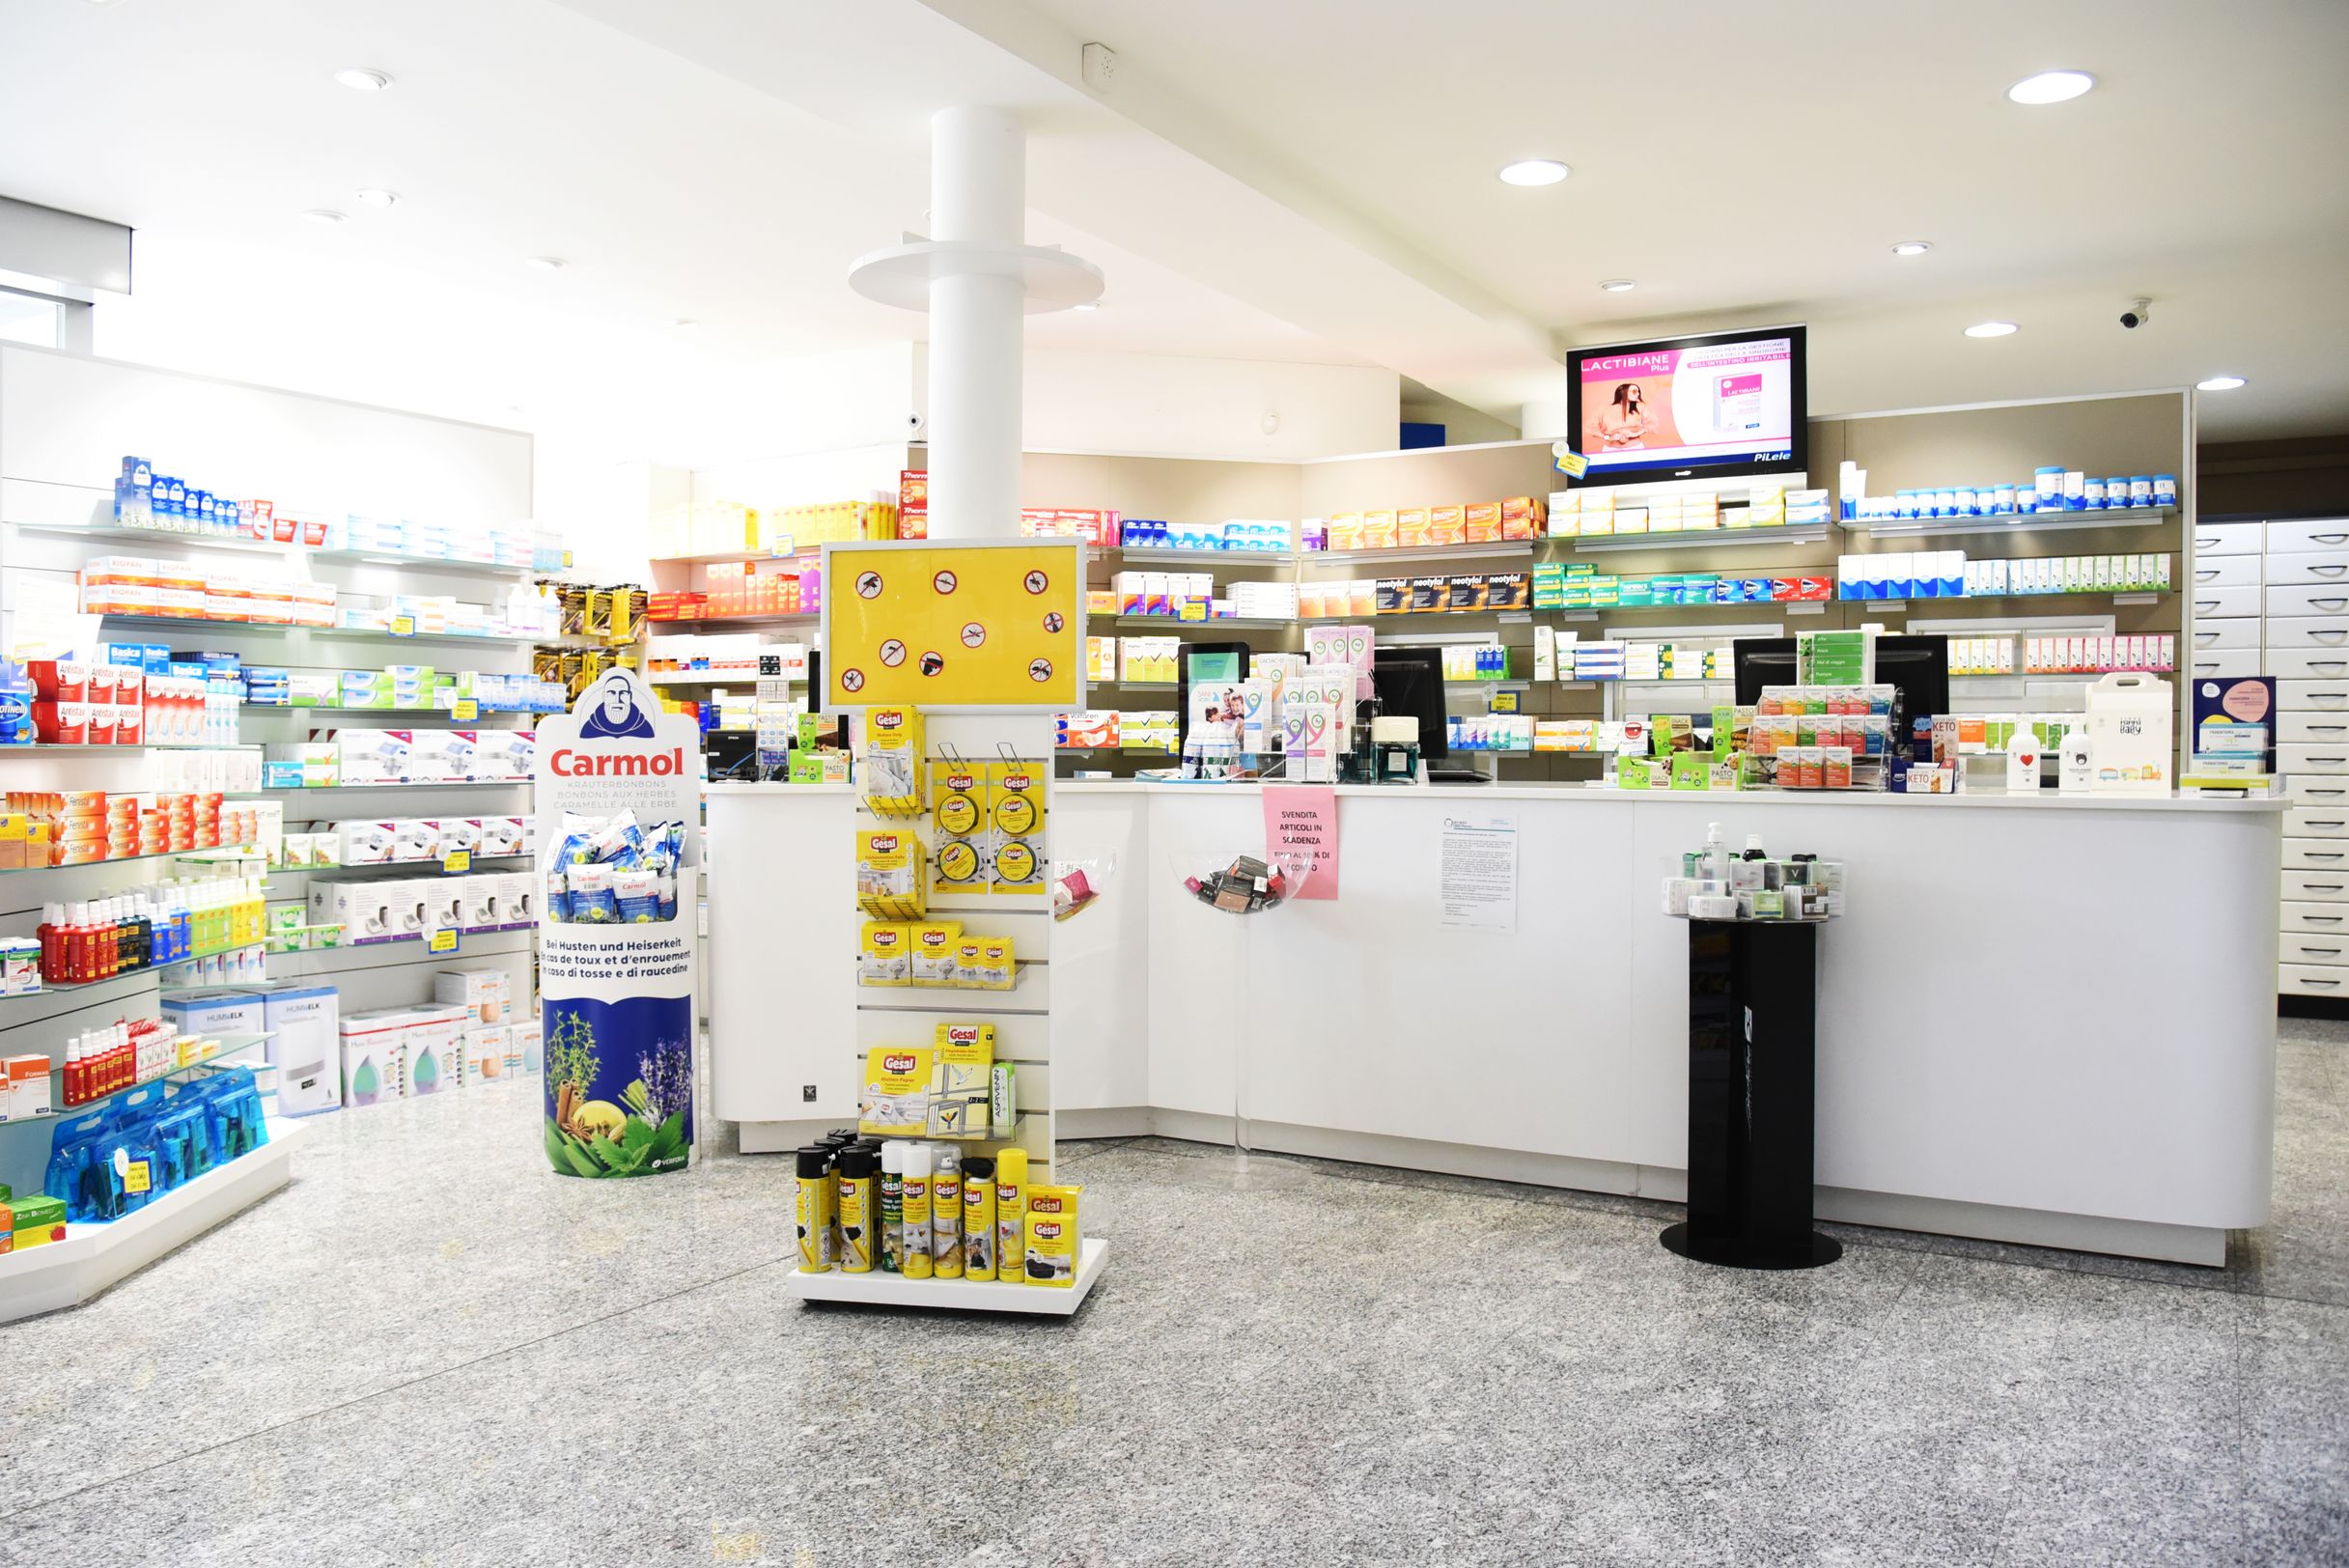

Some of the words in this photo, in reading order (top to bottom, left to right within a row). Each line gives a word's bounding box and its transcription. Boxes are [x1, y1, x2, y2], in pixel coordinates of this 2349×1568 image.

[1581, 353, 1669, 372] LACTIBIANE
[1650, 363, 1669, 372] Plus
[111, 647, 141, 657] Basica
[146, 648, 168, 657] Basica
[59, 664, 85, 675] Antistax
[92, 666, 115, 678] Antistax
[118, 668, 141, 680] Antistax
[172, 665, 203, 676] Basica
[60, 706, 86, 717] Antistax
[91, 707, 115, 718] Antistax
[118, 706, 142, 718] Antistax
[877, 715, 901, 725] Gesal
[1932, 721, 1956, 732] KETO
[550, 747, 684, 776] Carmol
[948, 778, 971, 788] Gesal
[1005, 778, 1028, 788] Gesal
[1908, 773, 1929, 783] KETO
[557, 791, 609, 799] BONBONS
[612, 790, 633, 798] AUX
[636, 790, 678, 798] HERBES
[553, 800, 617, 809] CARAMELLE
[621, 800, 647, 809] ALLE
[651, 799, 677, 808] ERBE
[872, 838, 896, 849] Gesal
[1282, 836, 1321, 845] SCADENZA
[622, 882, 646, 890] Carmol
[874, 934, 896, 942] Gesal
[923, 934, 944, 942] Gesal
[546, 939, 558, 950] Bei
[559, 940, 597, 951] Husten
[600, 941, 624, 951] und
[627, 938, 682, 950] Heiserkeit
[546, 954, 558, 963] cas
[560, 954, 572, 965] de
[574, 954, 601, 965] toux
[604, 955, 618, 965] et
[621, 950, 691, 965] d'enrouement
[547, 968, 566, 977] caso
[568, 966, 577, 977] di
[580, 967, 613, 978] tosse
[616, 969, 624, 978] e
[627, 966, 638, 977] di
[640, 964, 688, 977] raucedine
[949, 1028, 977, 1040] Gesal
[884, 1058, 914, 1070] Gesal
[840, 1185, 853, 1194] esal
[936, 1185, 958, 1193] Gesal
[1033, 1200, 1060, 1212] Gesal
[1035, 1225, 1060, 1235] Gesal
